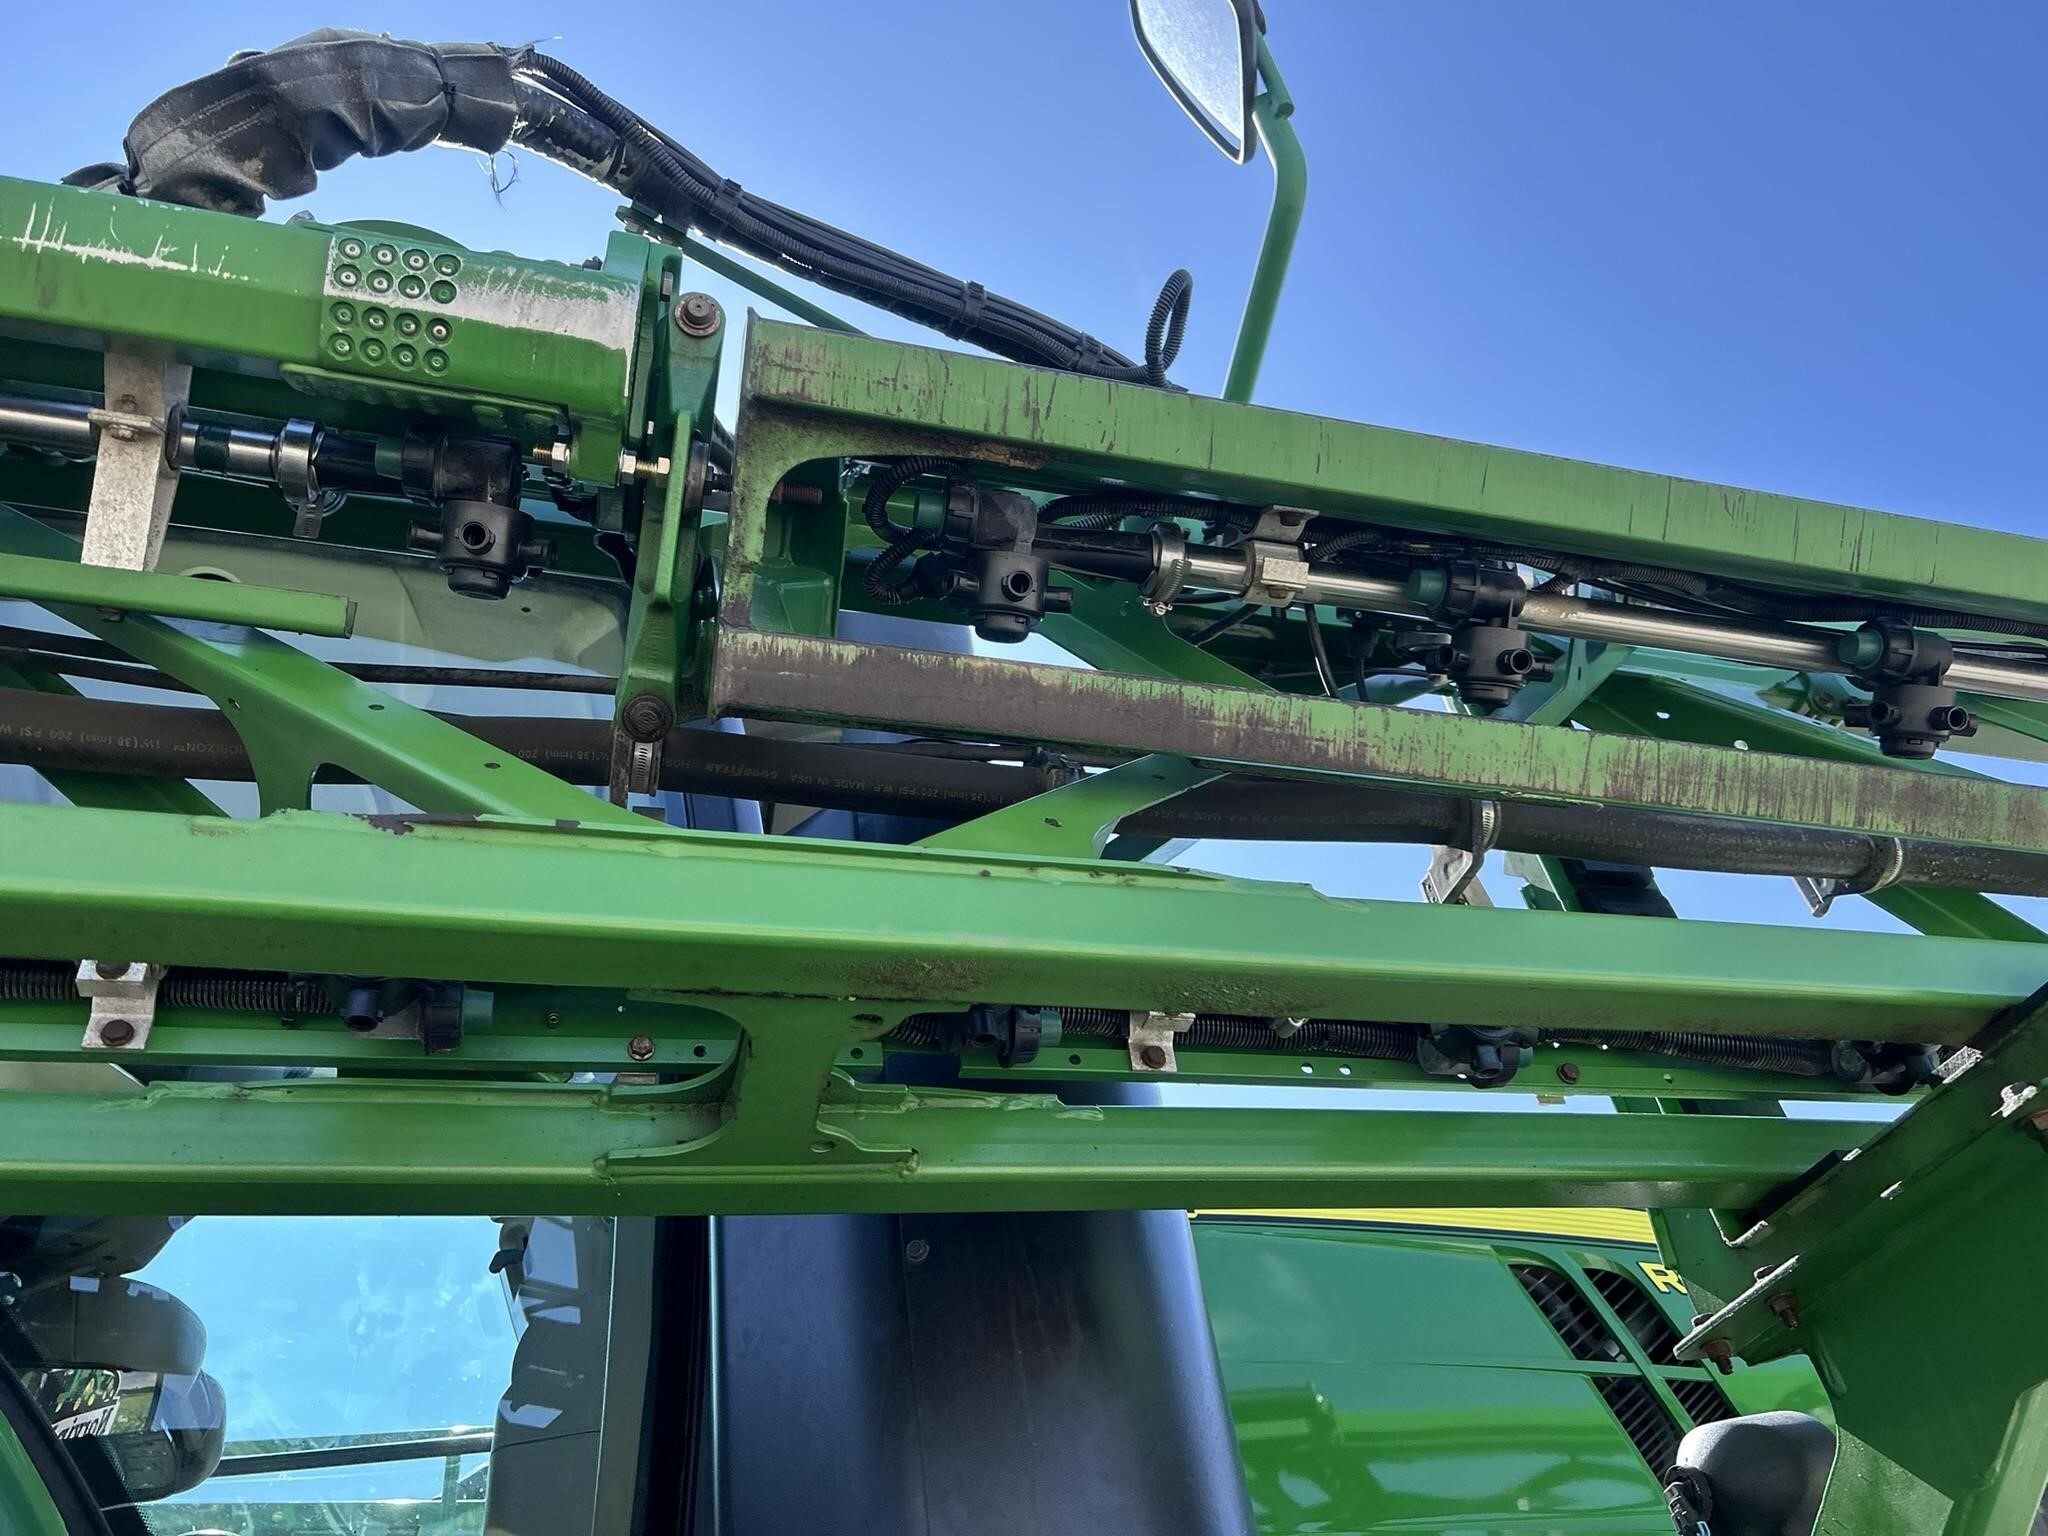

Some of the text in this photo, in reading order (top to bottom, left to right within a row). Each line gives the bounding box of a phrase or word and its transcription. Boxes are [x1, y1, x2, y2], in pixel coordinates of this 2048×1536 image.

[19, 726, 42, 739] PSI
[49, 729, 73, 742] 200
[790, 773, 813, 785] USA
[817, 776, 829, 786] IN
[832, 778, 866, 791] MADE
